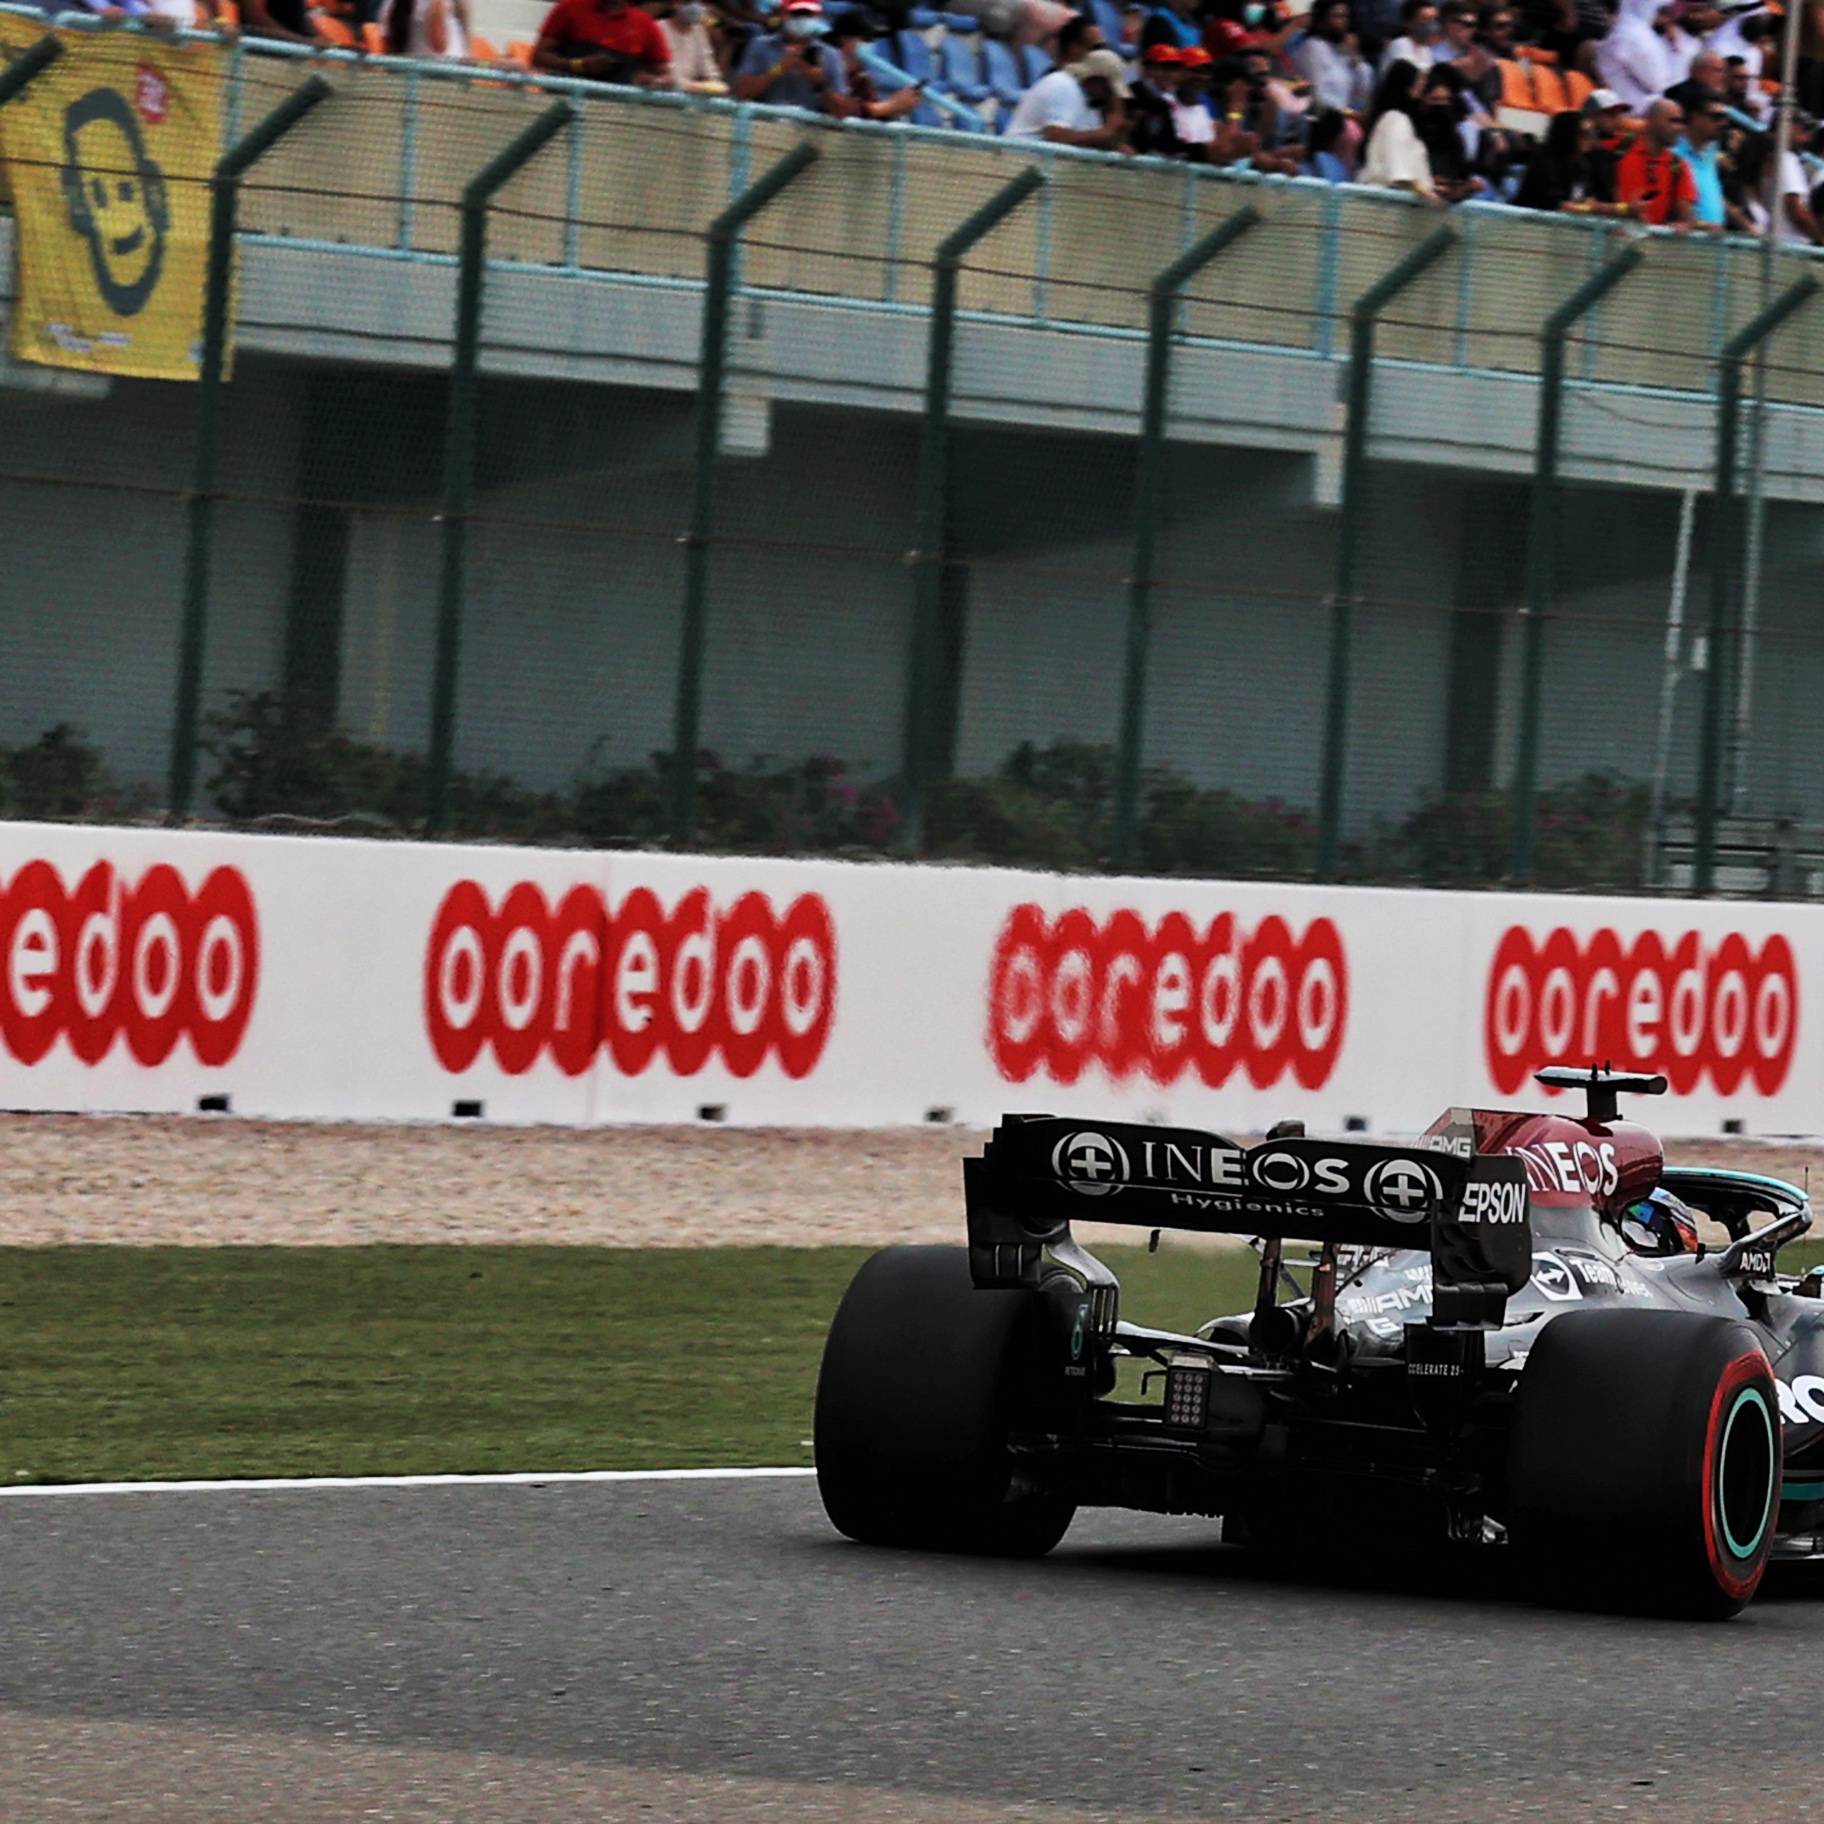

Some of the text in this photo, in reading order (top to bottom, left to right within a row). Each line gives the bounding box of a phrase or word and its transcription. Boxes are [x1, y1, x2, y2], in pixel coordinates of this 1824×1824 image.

[9, 864, 245, 1024] edoo
[438, 886, 824, 1040] ooredoo
[999, 909, 1336, 1053] ooredoo
[1495, 930, 1789, 1063] ooredoo
[1143, 1140, 1351, 1195] INEOS
[1170, 1191, 1325, 1218] Hygienics
[1457, 1182, 1528, 1225] EPSON
